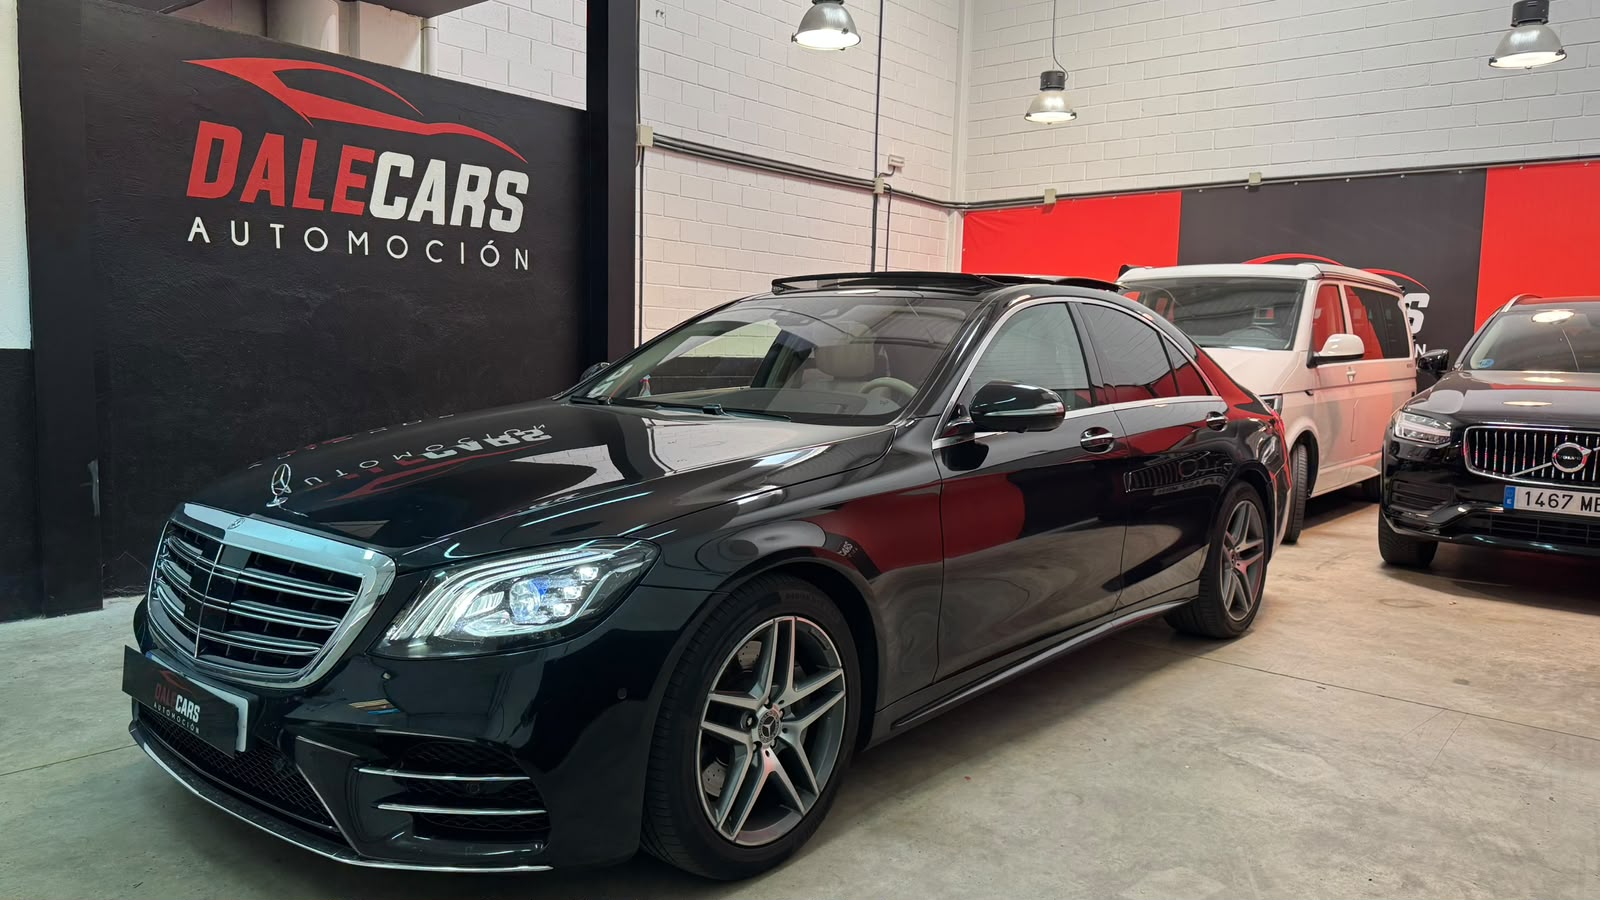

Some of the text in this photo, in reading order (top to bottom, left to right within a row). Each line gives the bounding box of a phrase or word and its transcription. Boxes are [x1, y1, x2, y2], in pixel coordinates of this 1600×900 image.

[186, 120, 529, 233] DALECARS
[187, 216, 529, 271] AUTOMOCIÓN
[1525, 491, 1573, 509] 1467
